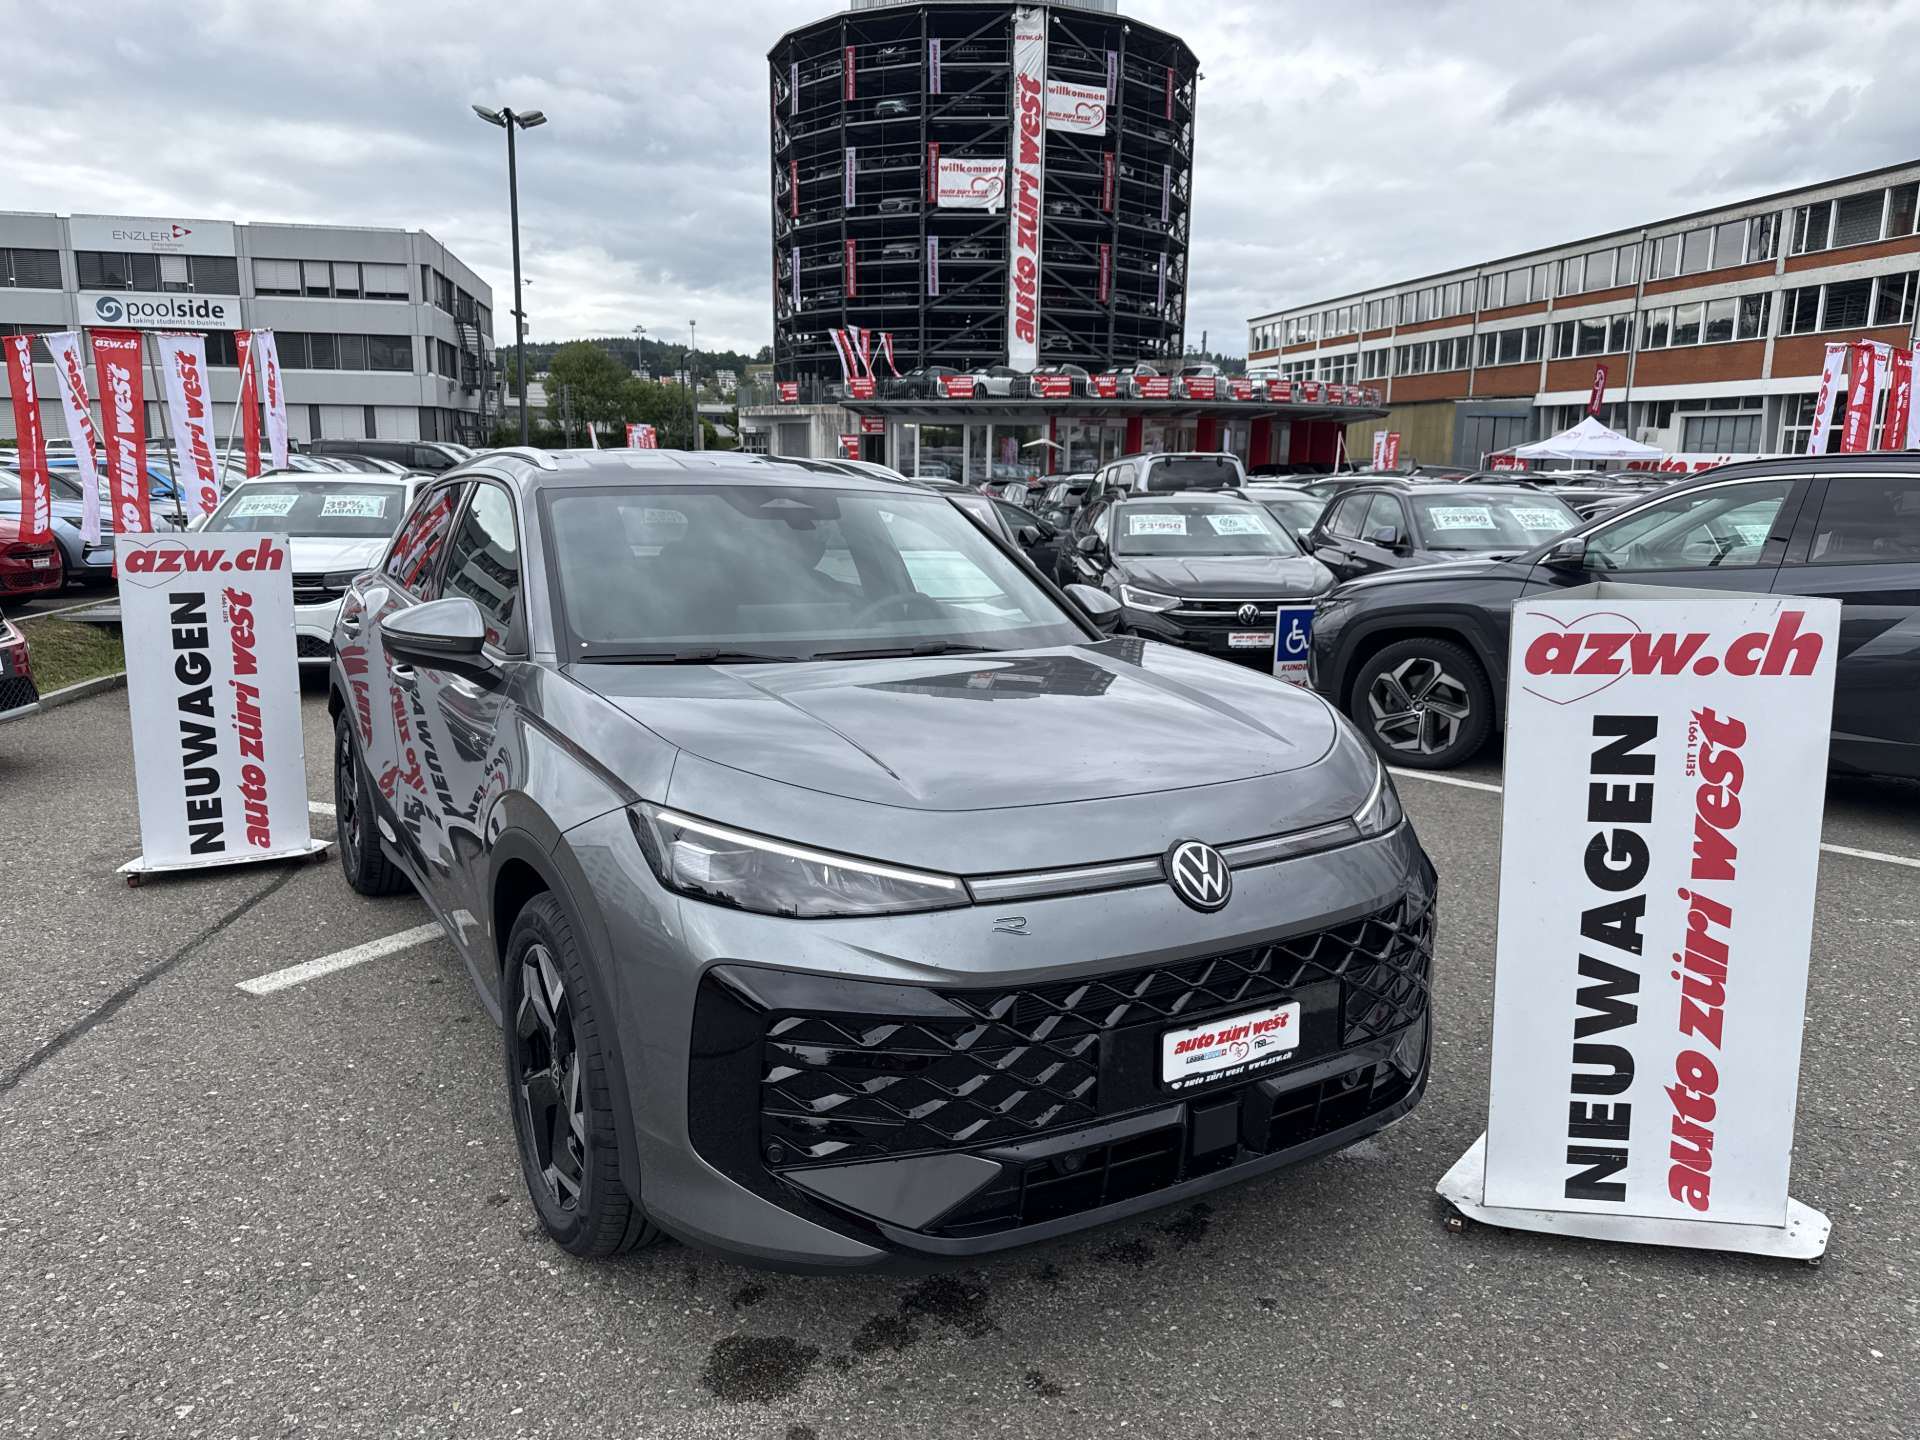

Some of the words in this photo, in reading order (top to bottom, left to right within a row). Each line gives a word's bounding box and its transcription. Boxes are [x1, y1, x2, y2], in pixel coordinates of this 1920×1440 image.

[1017, 72, 1041, 164] west
[1048, 86, 1106, 101] willkommen
[940, 164, 1004, 173] willkommen
[112, 231, 171, 241] ENZLER
[1013, 167, 1039, 257] züri
[126, 299, 225, 323] poolside
[133, 317, 155, 326] taking
[157, 318, 184, 326] students
[197, 319, 226, 327] business
[1013, 256, 1036, 344] auto
[95, 338, 138, 350] azw.ch
[109, 362, 136, 433] west
[175, 350, 204, 418] west
[114, 435, 140, 500] züri
[185, 421, 215, 483] züri
[326, 501, 365, 510] 39%
[125, 538, 284, 573] azw.ch
[222, 586, 258, 675] west
[1524, 611, 1824, 677] azw.ch
[168, 591, 227, 855] NEUWAGEN
[228, 679, 265, 763] züri
[1687, 721, 1699, 748] 1991
[1685, 753, 1697, 777] SEIT
[1690, 706, 1748, 882] west
[236, 764, 271, 849] auto
[1564, 714, 1659, 1203] NEUWAGEN
[1670, 887, 1734, 1051] züri
[1174, 1033, 1215, 1055] auto
[1215, 1022, 1252, 1045] züri
[1253, 1012, 1290, 1035] west
[1184, 1077, 1204, 1088] auto
[1205, 1070, 1224, 1082] züri
[1226, 1065, 1245, 1077] west
[1248, 1051, 1292, 1070] www.azw.ch
[1662, 1050, 1720, 1213] auto
